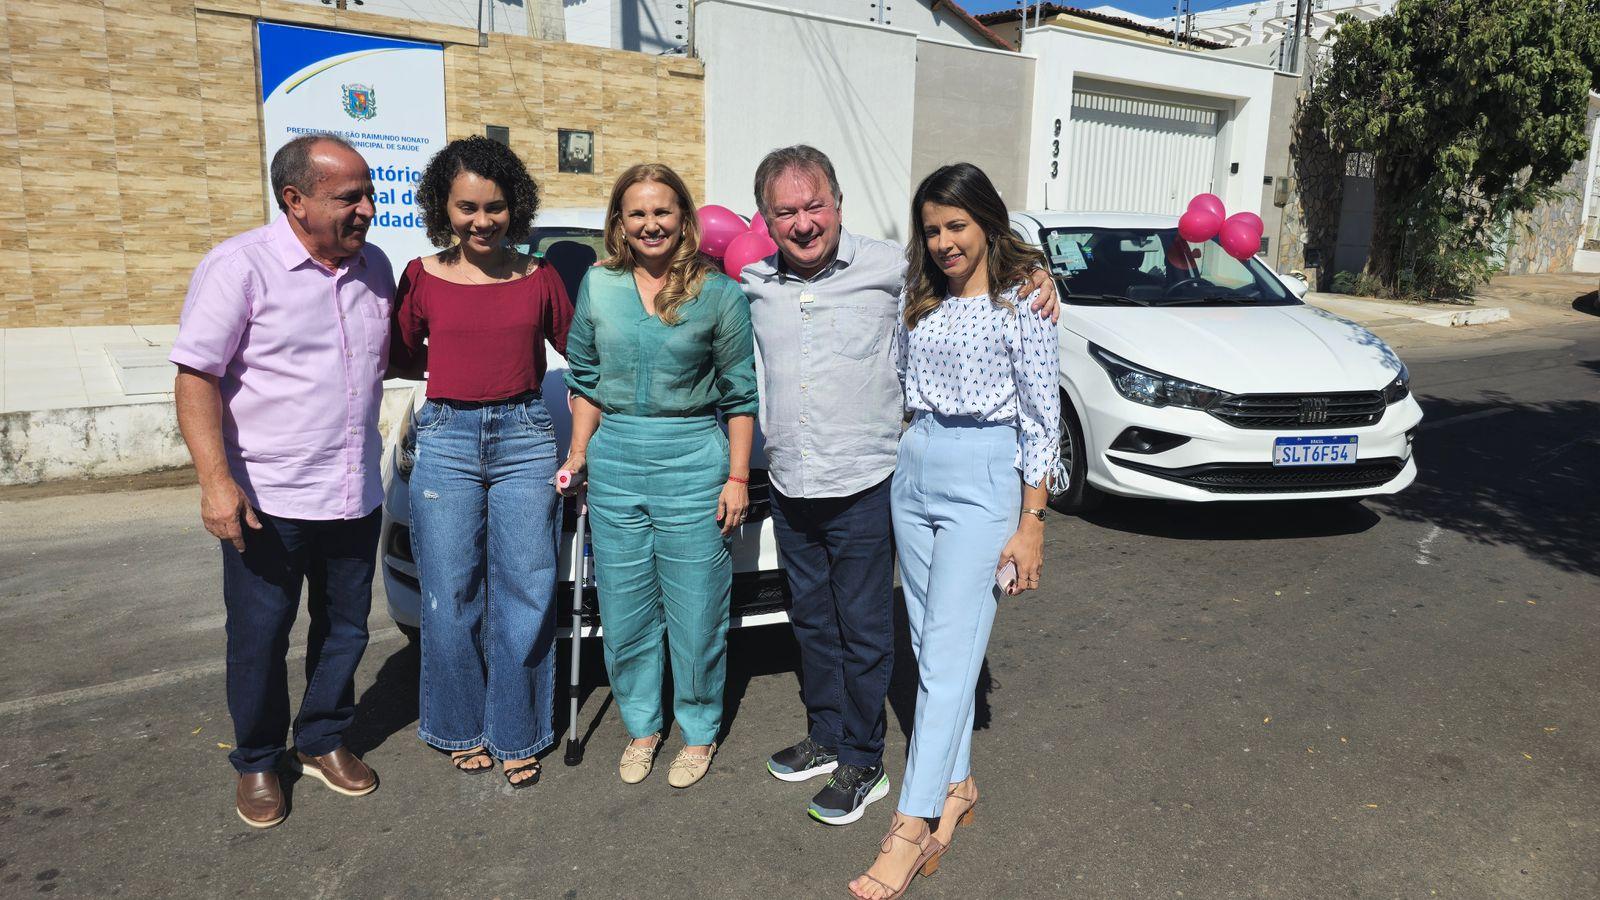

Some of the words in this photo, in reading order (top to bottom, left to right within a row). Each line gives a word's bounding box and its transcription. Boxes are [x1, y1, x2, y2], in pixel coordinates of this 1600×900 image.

[350, 140, 384, 149] UNICIPAL
[361, 132, 400, 142] RAIMUNDO
[401, 136, 430, 144] NONATO
[1051, 118, 1061, 179] 933
[369, 165, 423, 183] atório
[373, 211, 424, 228] idade
[1282, 445, 1348, 462] SLT6F54
